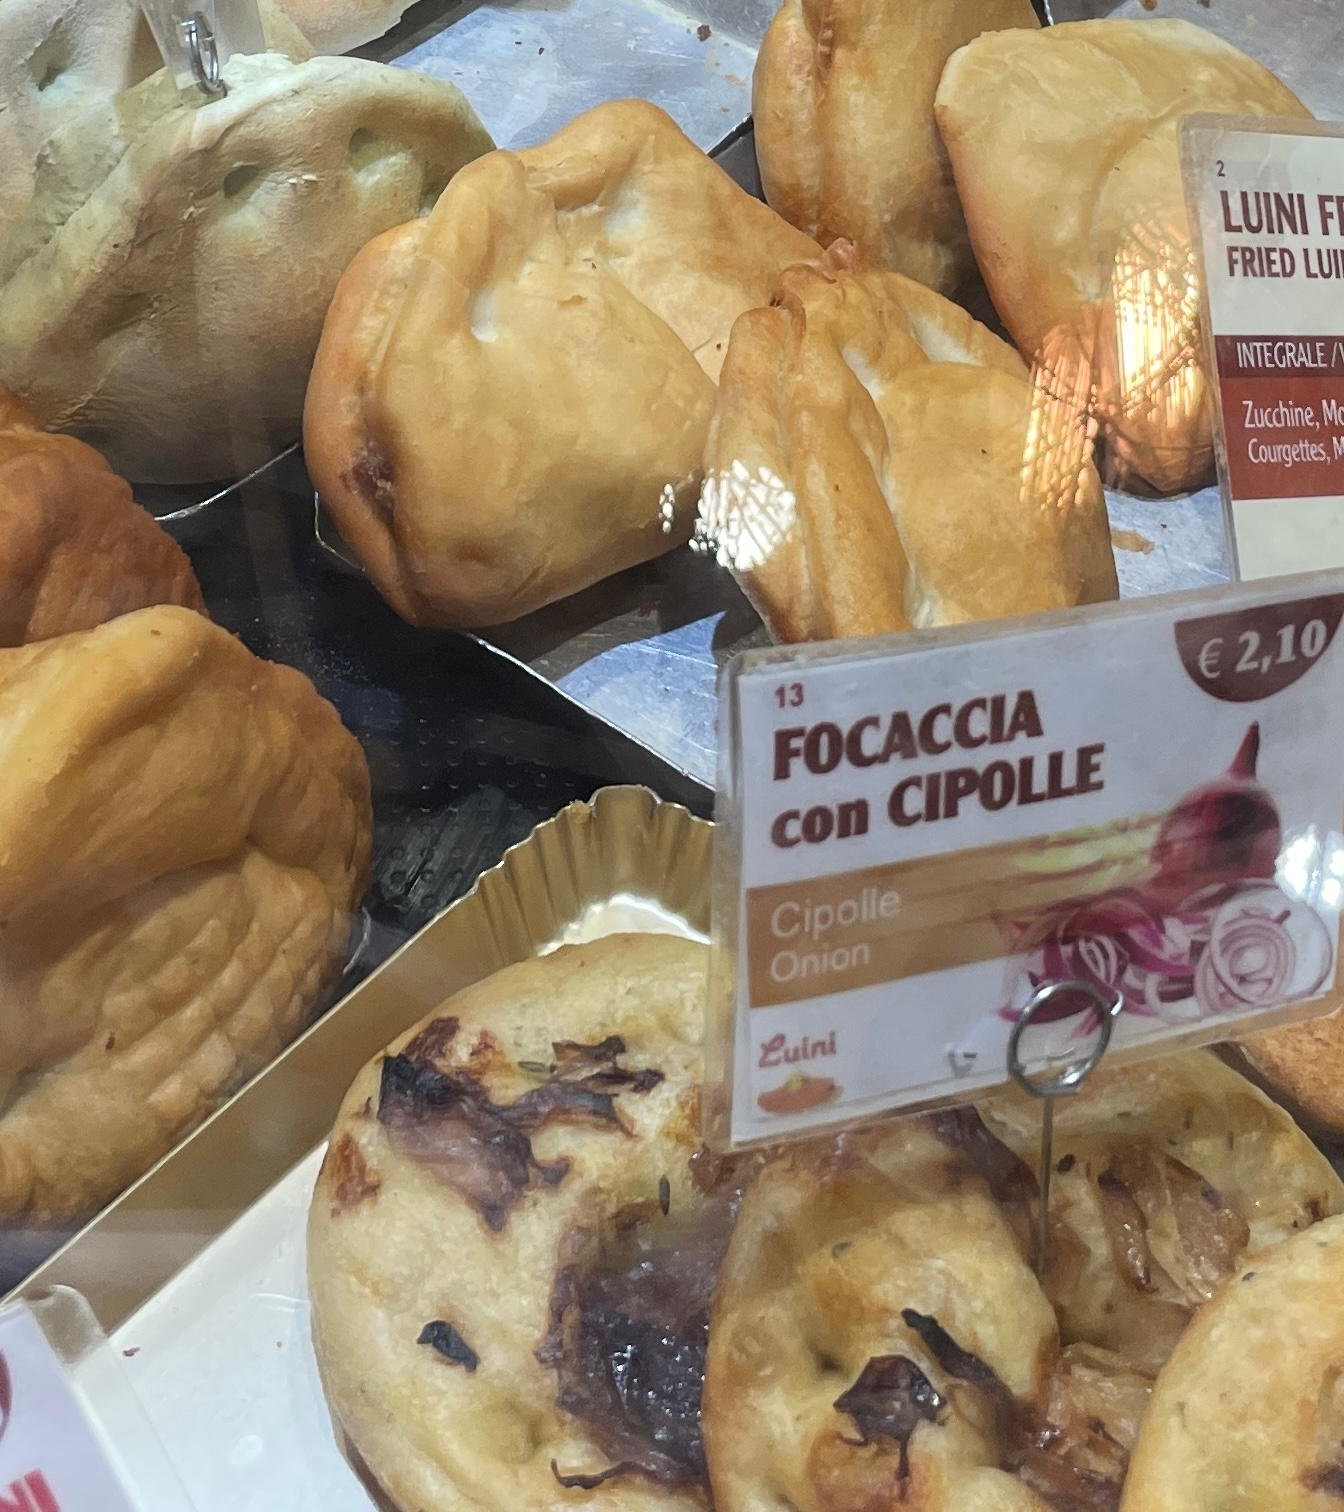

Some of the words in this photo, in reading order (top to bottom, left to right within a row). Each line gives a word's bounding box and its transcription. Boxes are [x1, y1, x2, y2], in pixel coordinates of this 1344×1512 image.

[1215, 160, 1226, 177] 2
[1220, 190, 1308, 236] LUINI
[1227, 245, 1296, 280] FRIED
[1236, 341, 1327, 369] INTEGRALE
[1242, 399, 1321, 430] Zucchine,
[1247, 437, 1331, 468] Courgettes,
[1196, 637, 1225, 679] €
[1234, 618, 1328, 674] 2,10
[773, 683, 805, 708] 13
[772, 690, 1044, 780] FOCACCIA
[770, 797, 870, 849] con
[887, 742, 1105, 828] CIPOLLE
[770, 885, 902, 941] Cipolle
[769, 940, 871, 984] Onion
[758, 1030, 837, 1068] Luini
